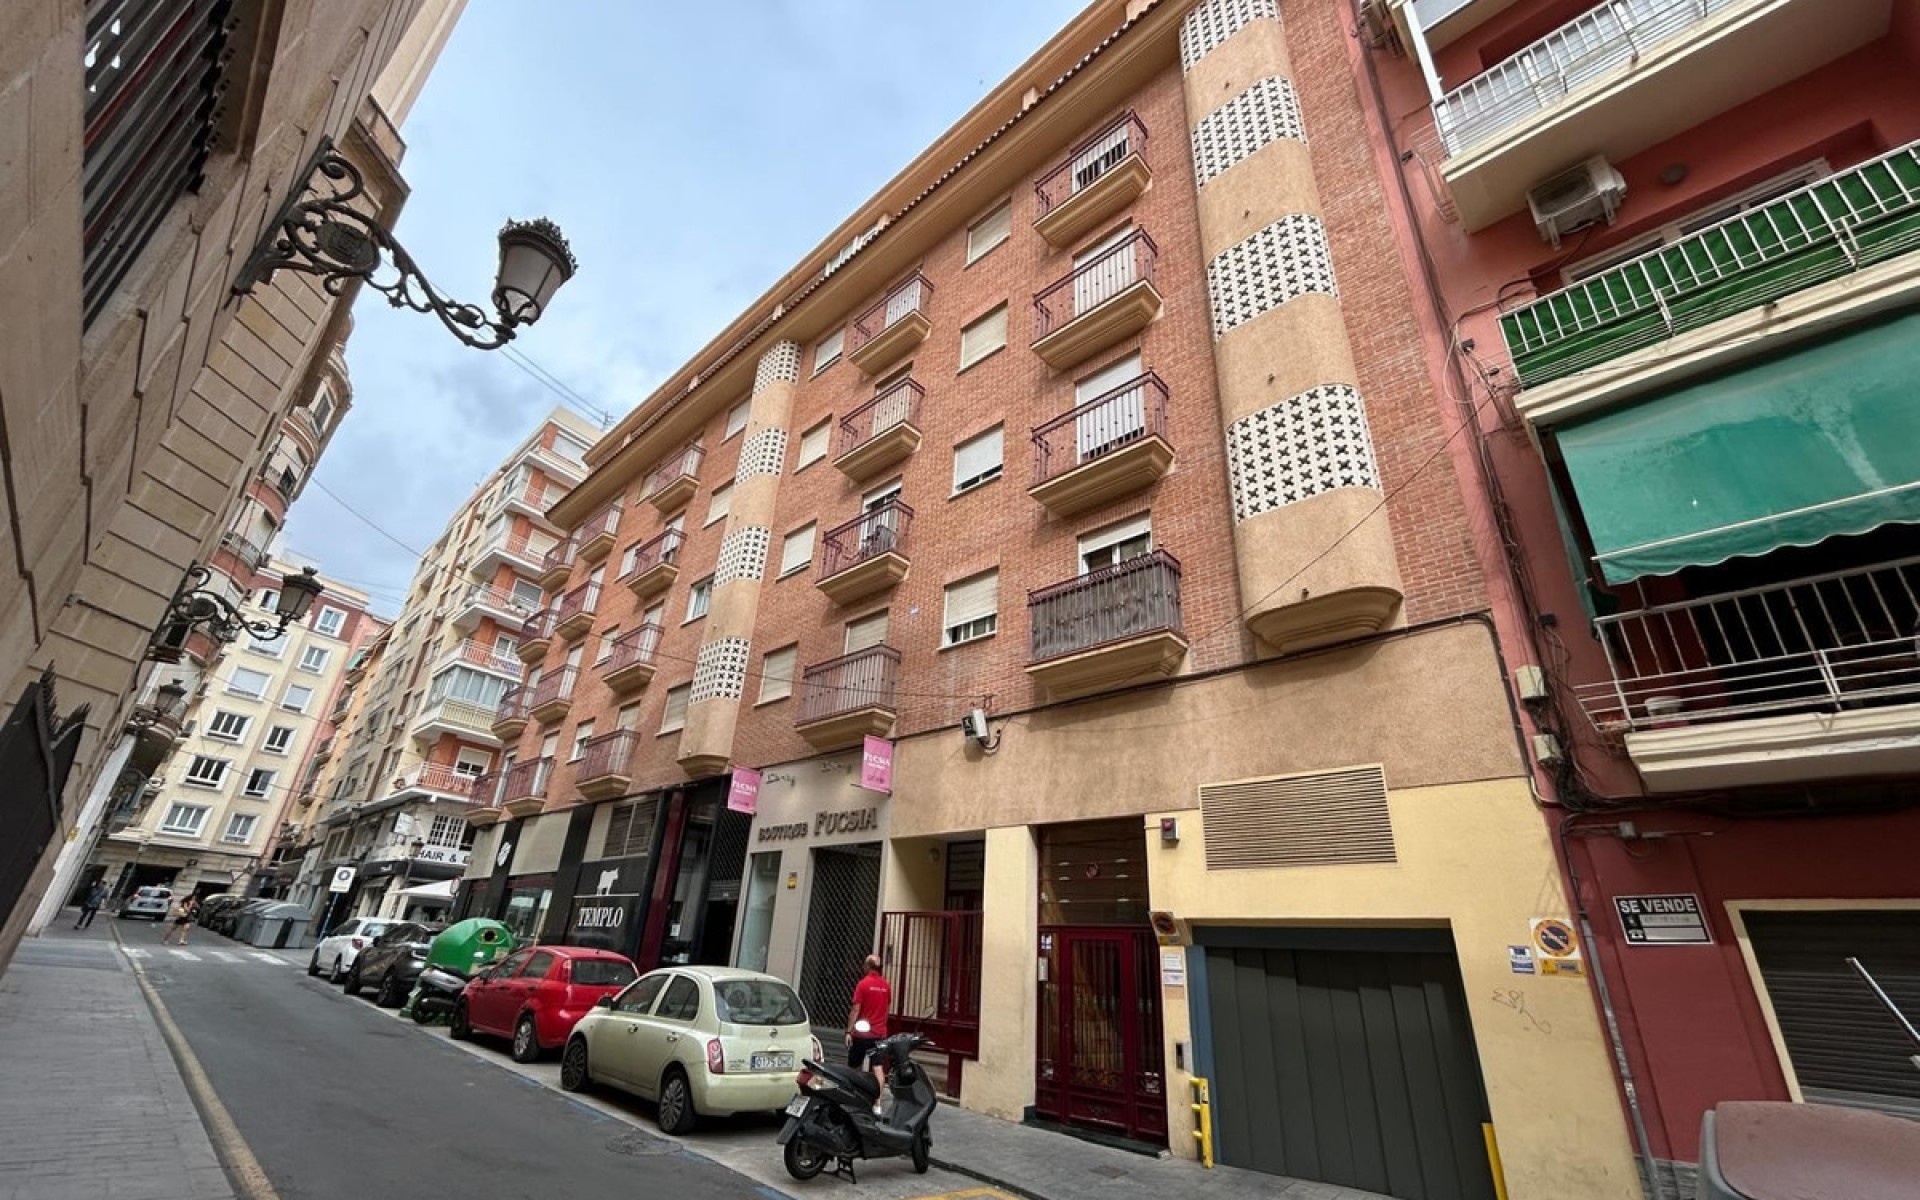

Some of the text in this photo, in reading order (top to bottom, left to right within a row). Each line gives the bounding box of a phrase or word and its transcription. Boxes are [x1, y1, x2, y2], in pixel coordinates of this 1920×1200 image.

[758, 808, 877, 842] BOUTIQUE FUCSIA
[420, 849, 444, 861] HAIR
[1619, 899, 1696, 913] SE VENDE
[577, 906, 623, 928] TEMPLO
